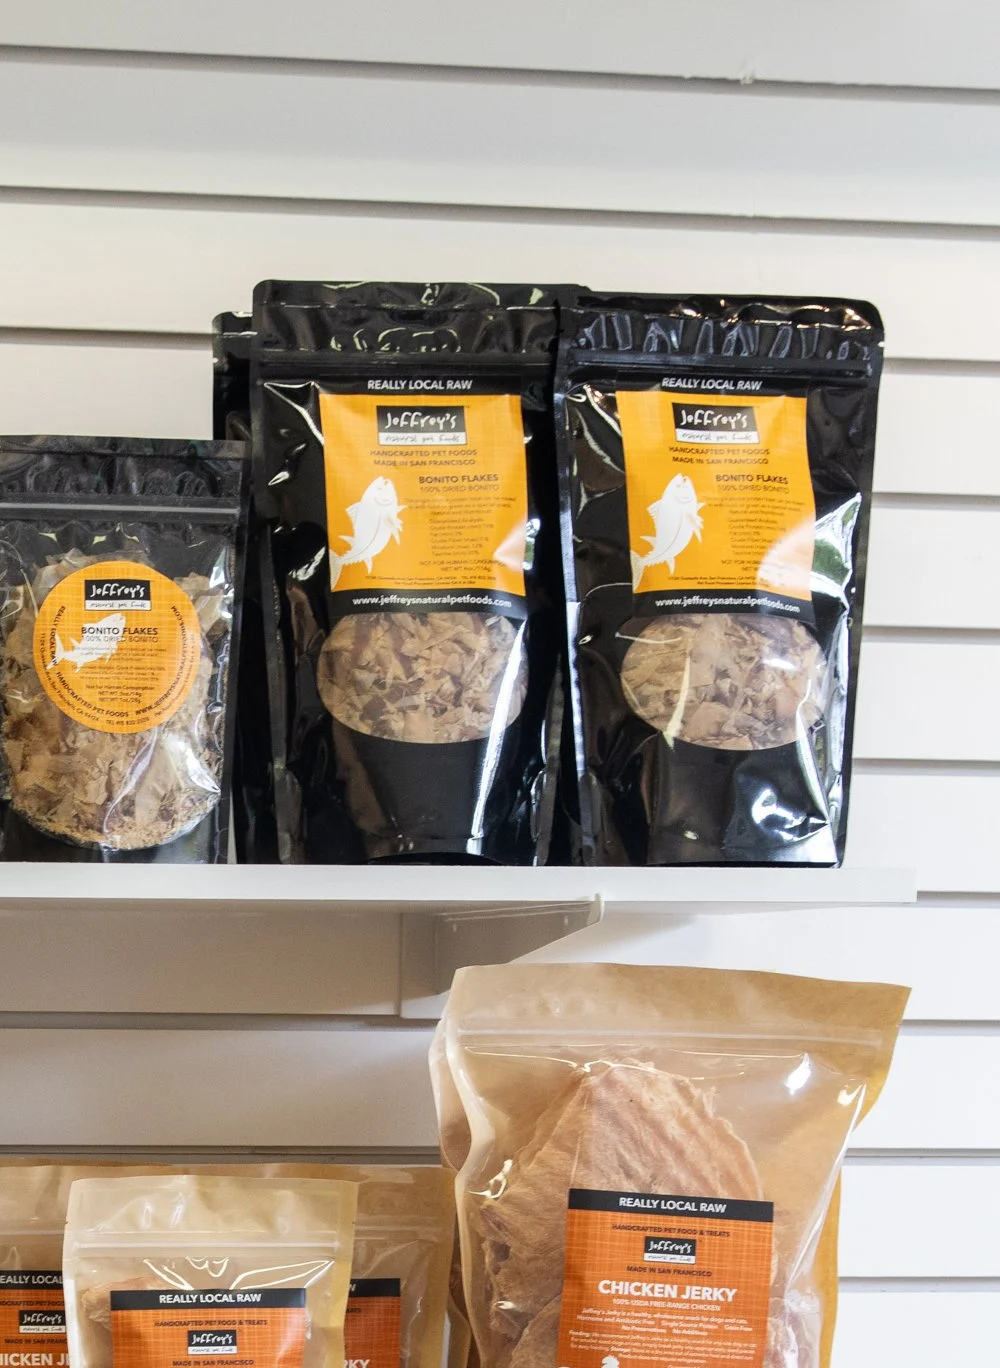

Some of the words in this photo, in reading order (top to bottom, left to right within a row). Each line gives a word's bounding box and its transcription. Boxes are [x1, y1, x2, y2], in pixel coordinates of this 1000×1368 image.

[368, 380, 406, 389] REALLY
[409, 380, 444, 389] LOCAL
[446, 380, 472, 389] RAW
[662, 378, 700, 388] REALLY
[701, 379, 735, 389] LOCAL
[737, 381, 762, 390] RAW
[385, 412, 457, 429] Jeffrey's
[680, 410, 747, 428] Jeffrey's
[419, 475, 458, 484] BONITO
[462, 474, 498, 482] FLAKES
[716, 474, 754, 482] BONITO
[756, 475, 788, 484] FLAKES
[90, 584, 145, 598] Jeffrey's
[353, 595, 511, 607] www.jeffreysnaturalpetfoods.com
[655, 596, 800, 612] www.jeffreysnaturalpetfoods.com
[82, 627, 120, 635] BONITO
[619, 1198, 659, 1209] REALLY
[661, 1200, 698, 1211] LOCAL
[700, 1203, 726, 1213] RAW
[649, 1241, 692, 1254] Jeffrey's
[32, 1275, 63, 1284] LOCAL
[599, 1280, 678, 1298] CHICKEN
[680, 1285, 738, 1301] JERKY
[159, 1294, 198, 1304] REALLY
[200, 1294, 235, 1303] LOCAL
[237, 1293, 261, 1302] RAW
[23, 1313, 62, 1325] Jeffrey's
[191, 1333, 232, 1345] Jeffrey's
